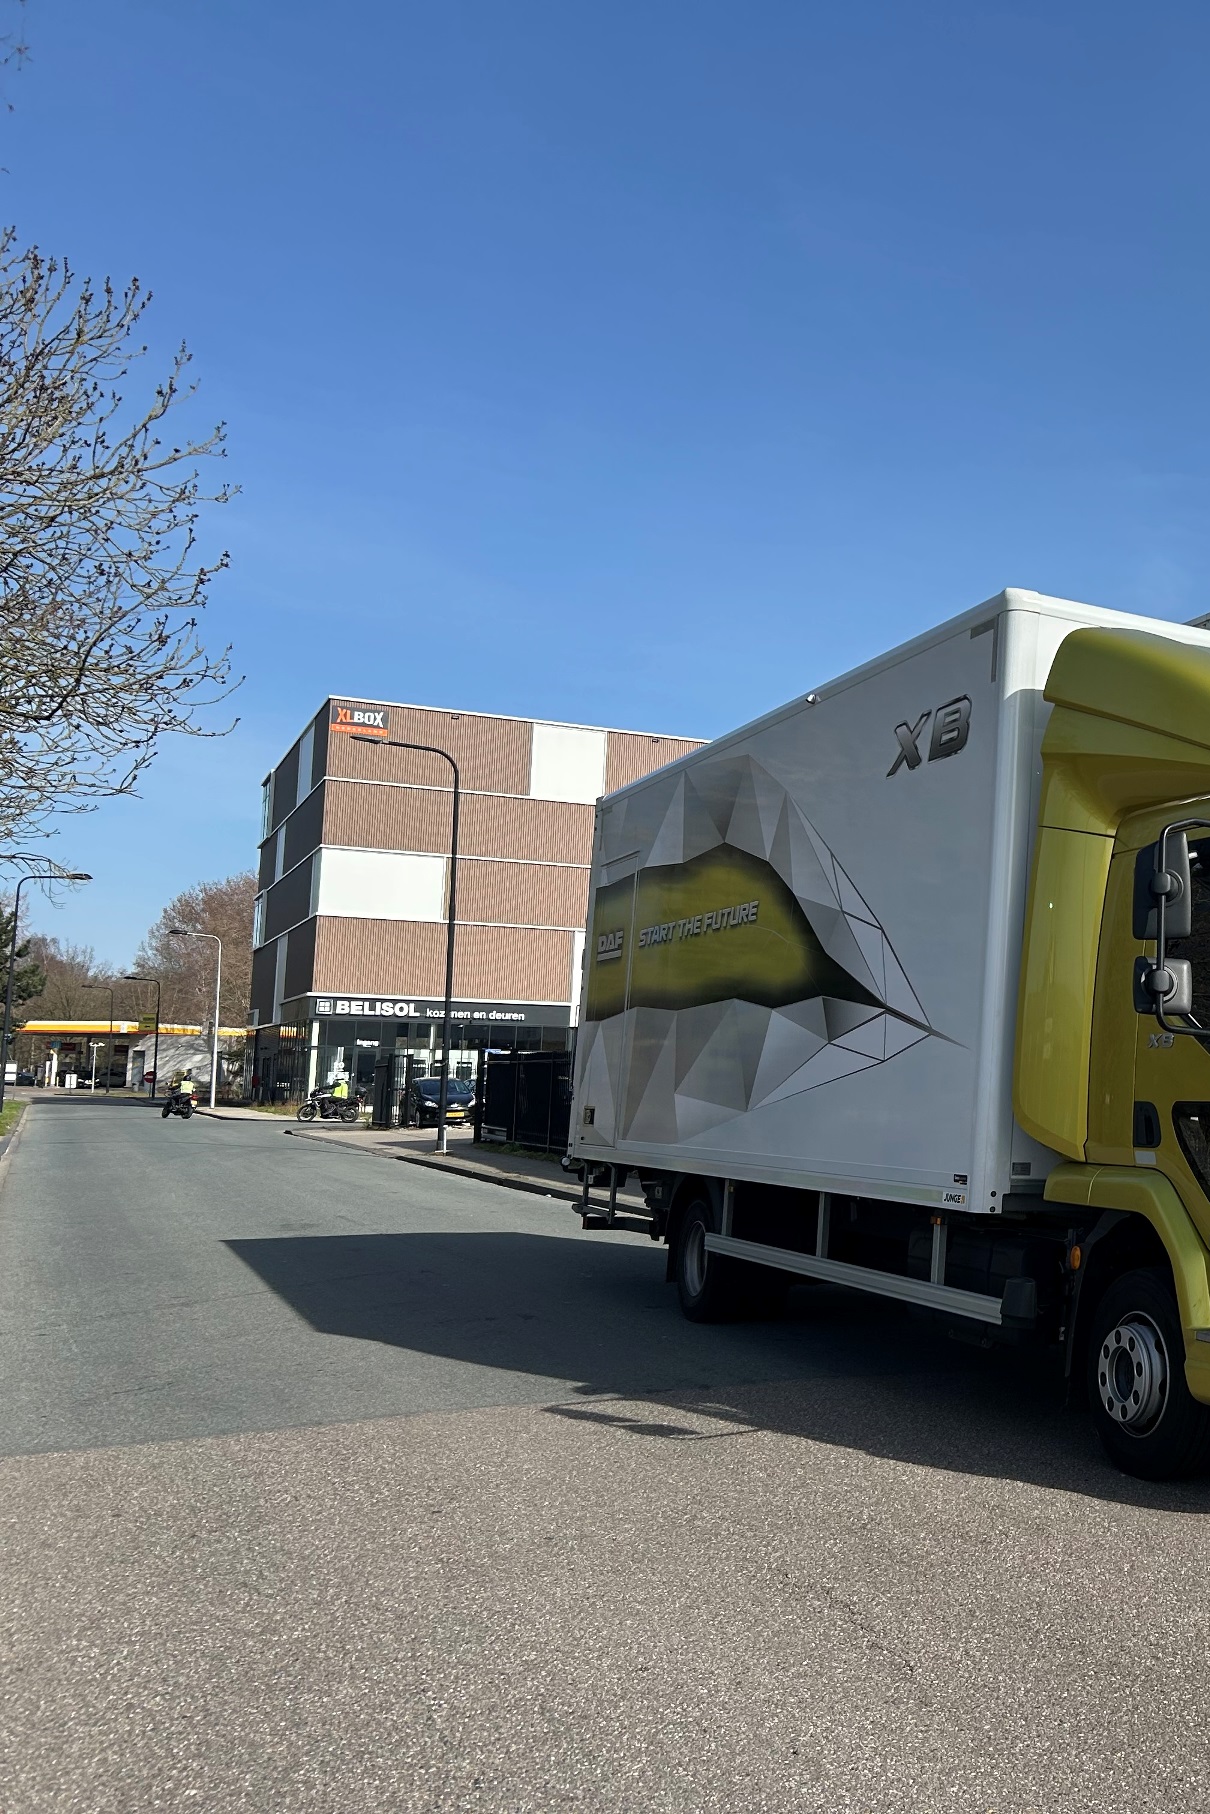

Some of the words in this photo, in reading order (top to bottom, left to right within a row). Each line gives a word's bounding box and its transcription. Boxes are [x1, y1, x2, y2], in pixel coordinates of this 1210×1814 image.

[886, 694, 973, 779] XB
[638, 921, 676, 947] START
[677, 915, 702, 939] THE
[703, 901, 760, 932] FUTURE
[598, 930, 624, 951] DAF
[335, 1000, 420, 1017] BELISOL
[426, 1008, 471, 1019] koznen
[473, 1010, 487, 1019] en
[489, 1010, 525, 1020] deuren
[1147, 1032, 1175, 1048] XB
[943, 1193, 961, 1204] JUNGE
